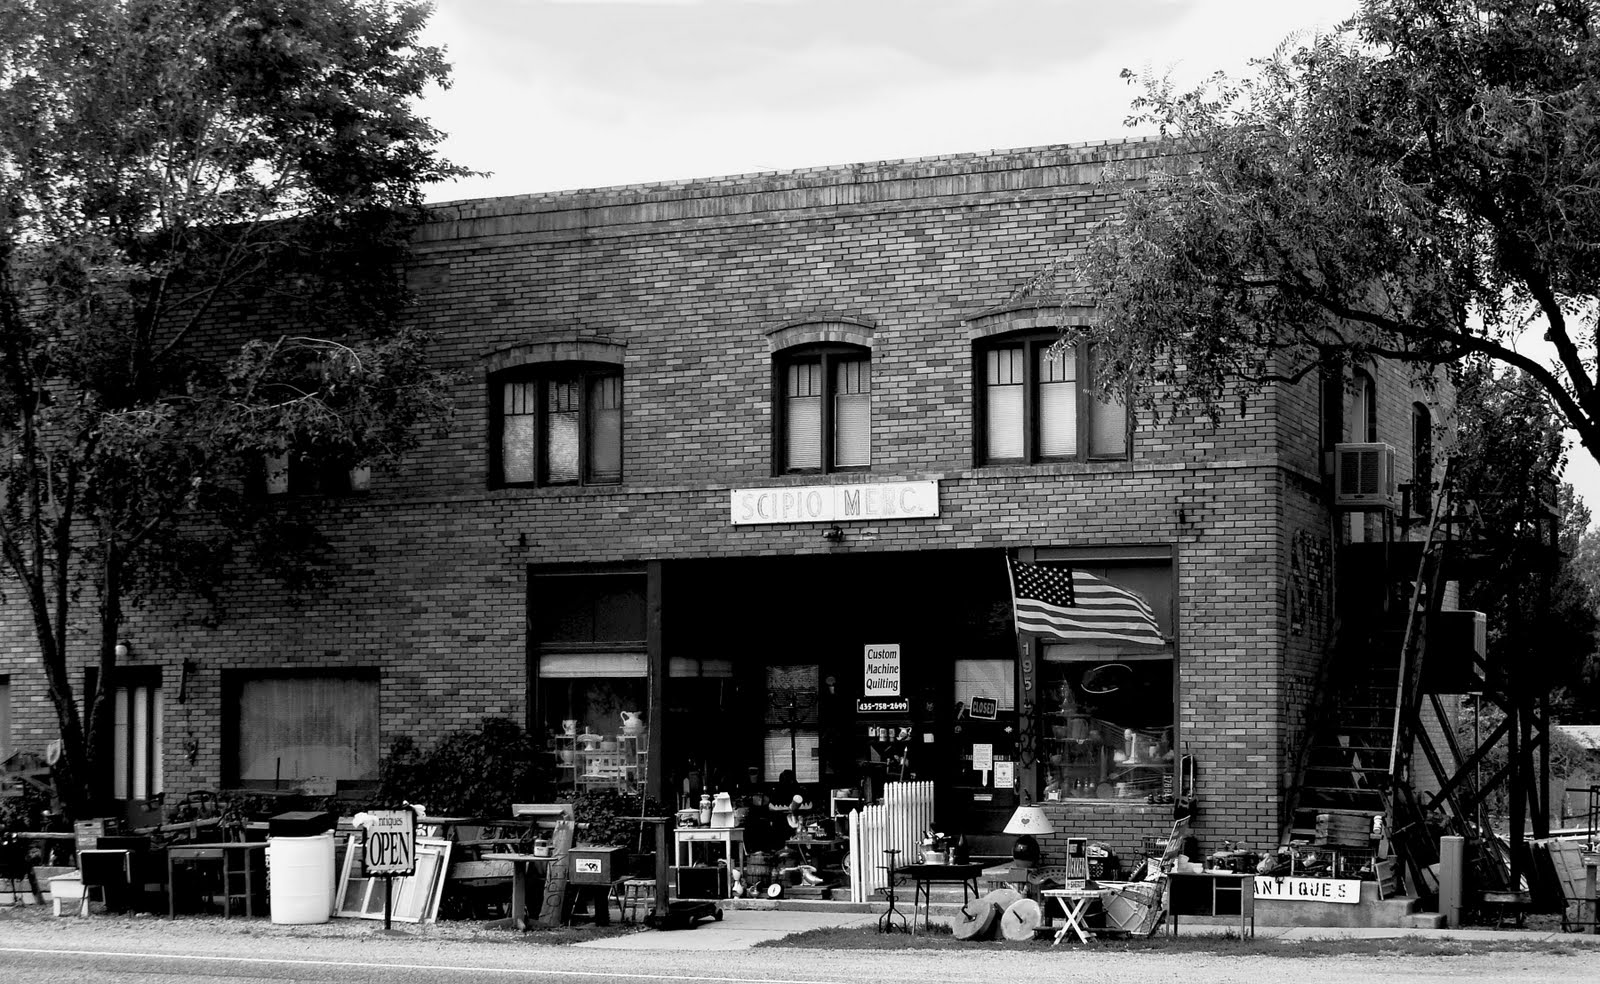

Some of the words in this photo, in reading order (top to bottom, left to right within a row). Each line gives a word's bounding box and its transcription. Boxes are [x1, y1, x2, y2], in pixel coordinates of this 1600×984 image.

[742, 490, 823, 520] SCIPIO
[844, 486, 924, 516] MERC.
[867, 648, 897, 660] Custom
[865, 663, 899, 675] Machine
[866, 677, 898, 691] Quilting
[972, 701, 995, 714] CLOSED
[370, 832, 410, 866] OPEN
[546, 854, 568, 907] OPEN
